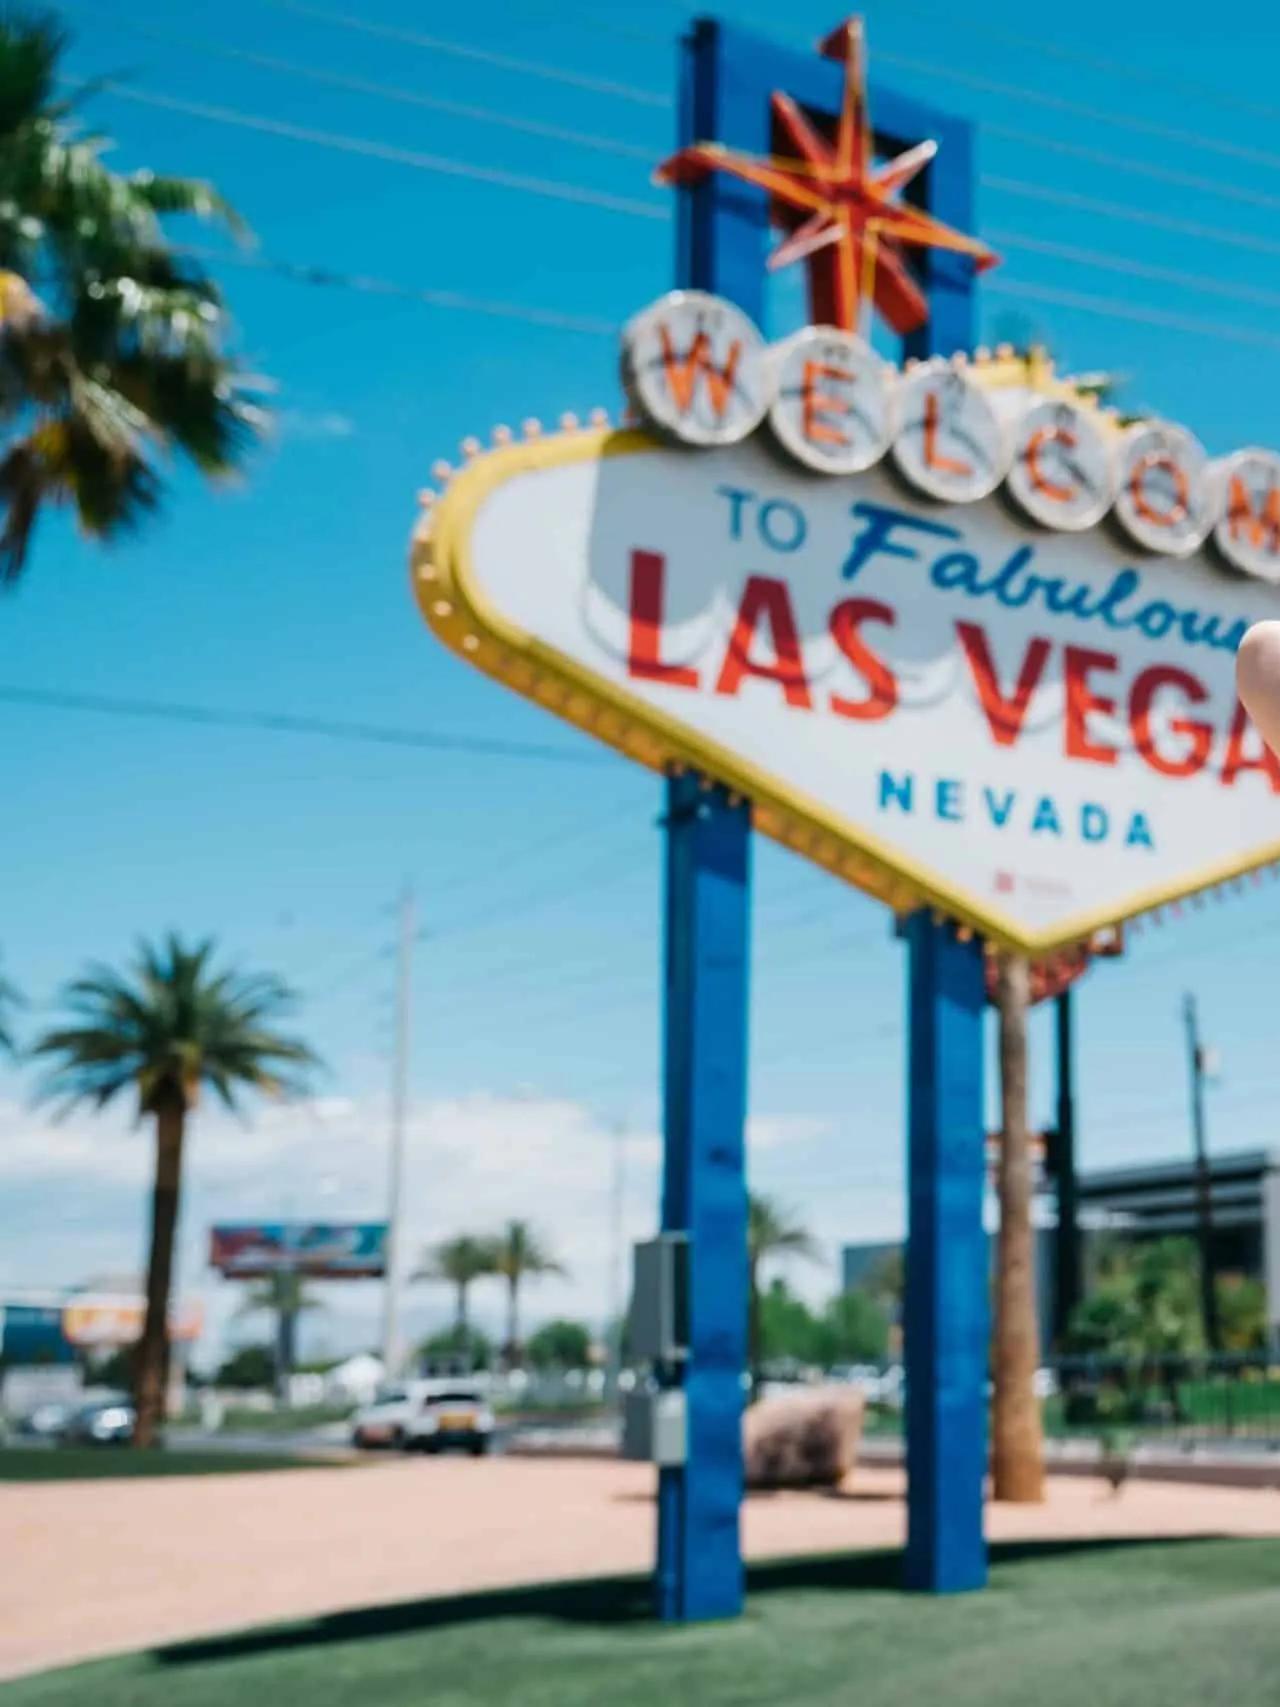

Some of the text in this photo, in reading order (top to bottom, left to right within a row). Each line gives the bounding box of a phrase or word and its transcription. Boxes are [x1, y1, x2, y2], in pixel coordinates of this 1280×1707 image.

[719, 486, 808, 553] TO
[627, 548, 898, 721] LAS
[878, 769, 1155, 850] NEVADA
